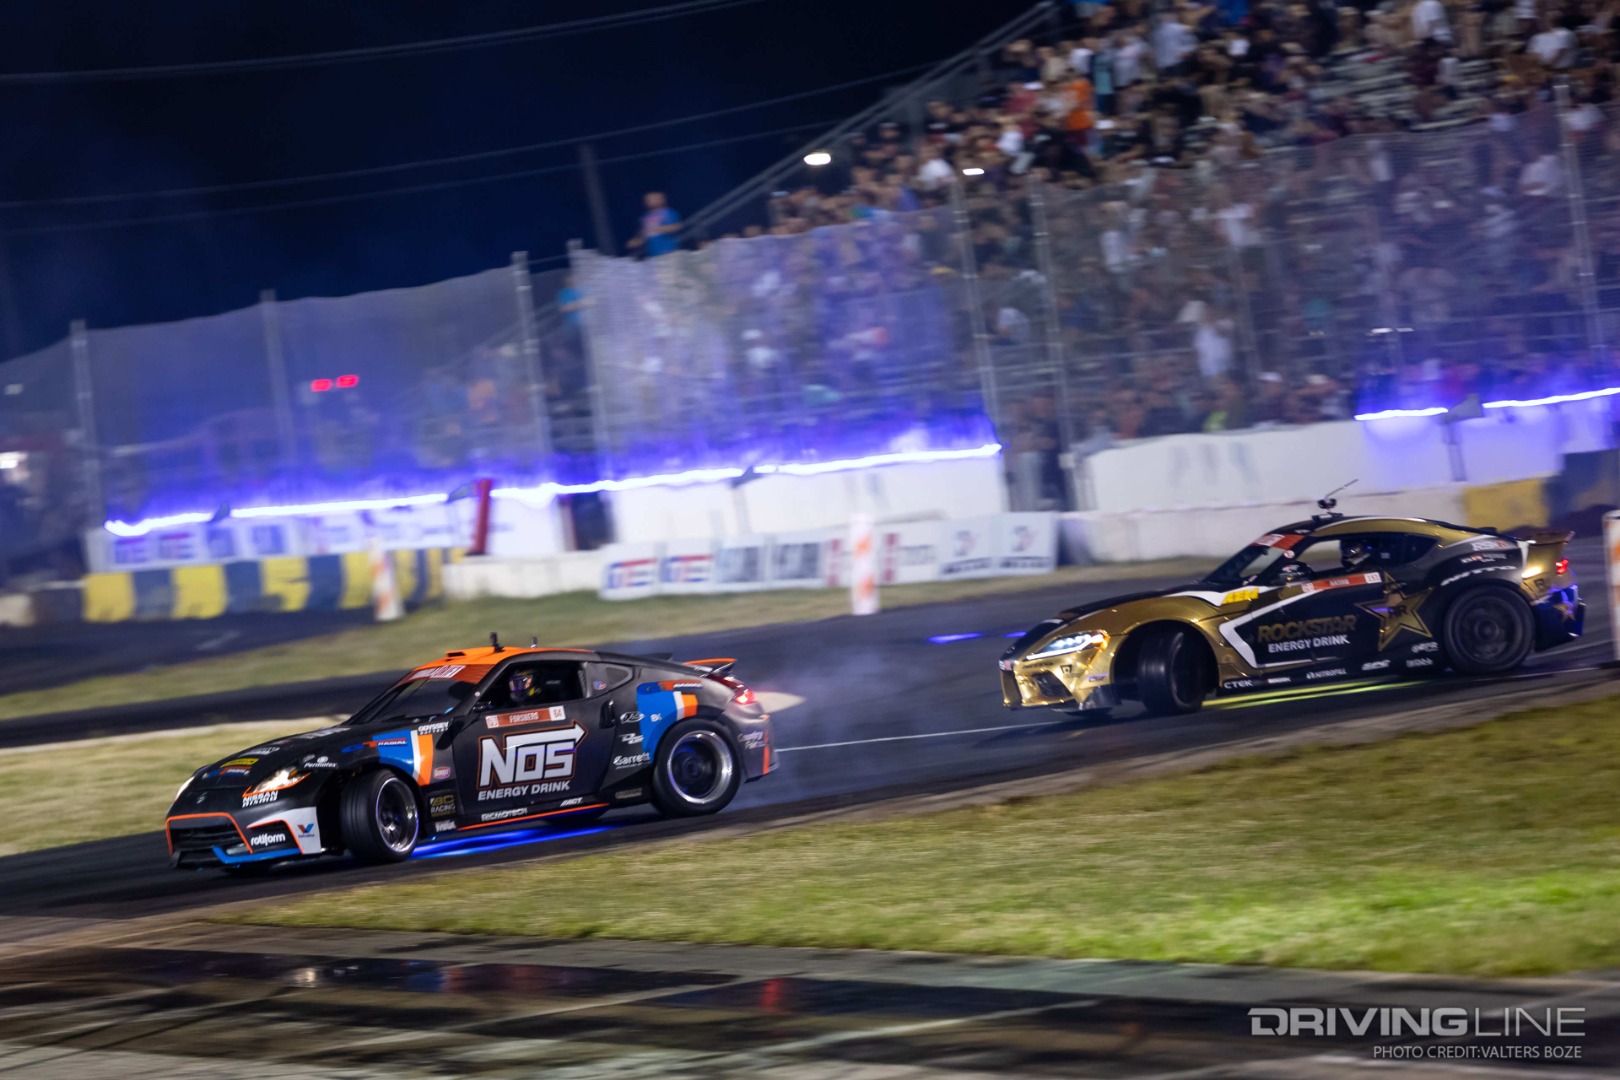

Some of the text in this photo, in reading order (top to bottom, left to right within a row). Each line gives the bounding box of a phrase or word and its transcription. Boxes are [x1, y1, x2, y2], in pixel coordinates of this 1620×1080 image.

[1258, 614, 1357, 643] ROCKSTAR
[1268, 634, 1350, 653] ENERGY DRINK
[1224, 680, 1252, 689] CTEK
[480, 723, 585, 787] NOS
[477, 780, 571, 801] ENERGY DRINK
[250, 833, 286, 846] rotiform
